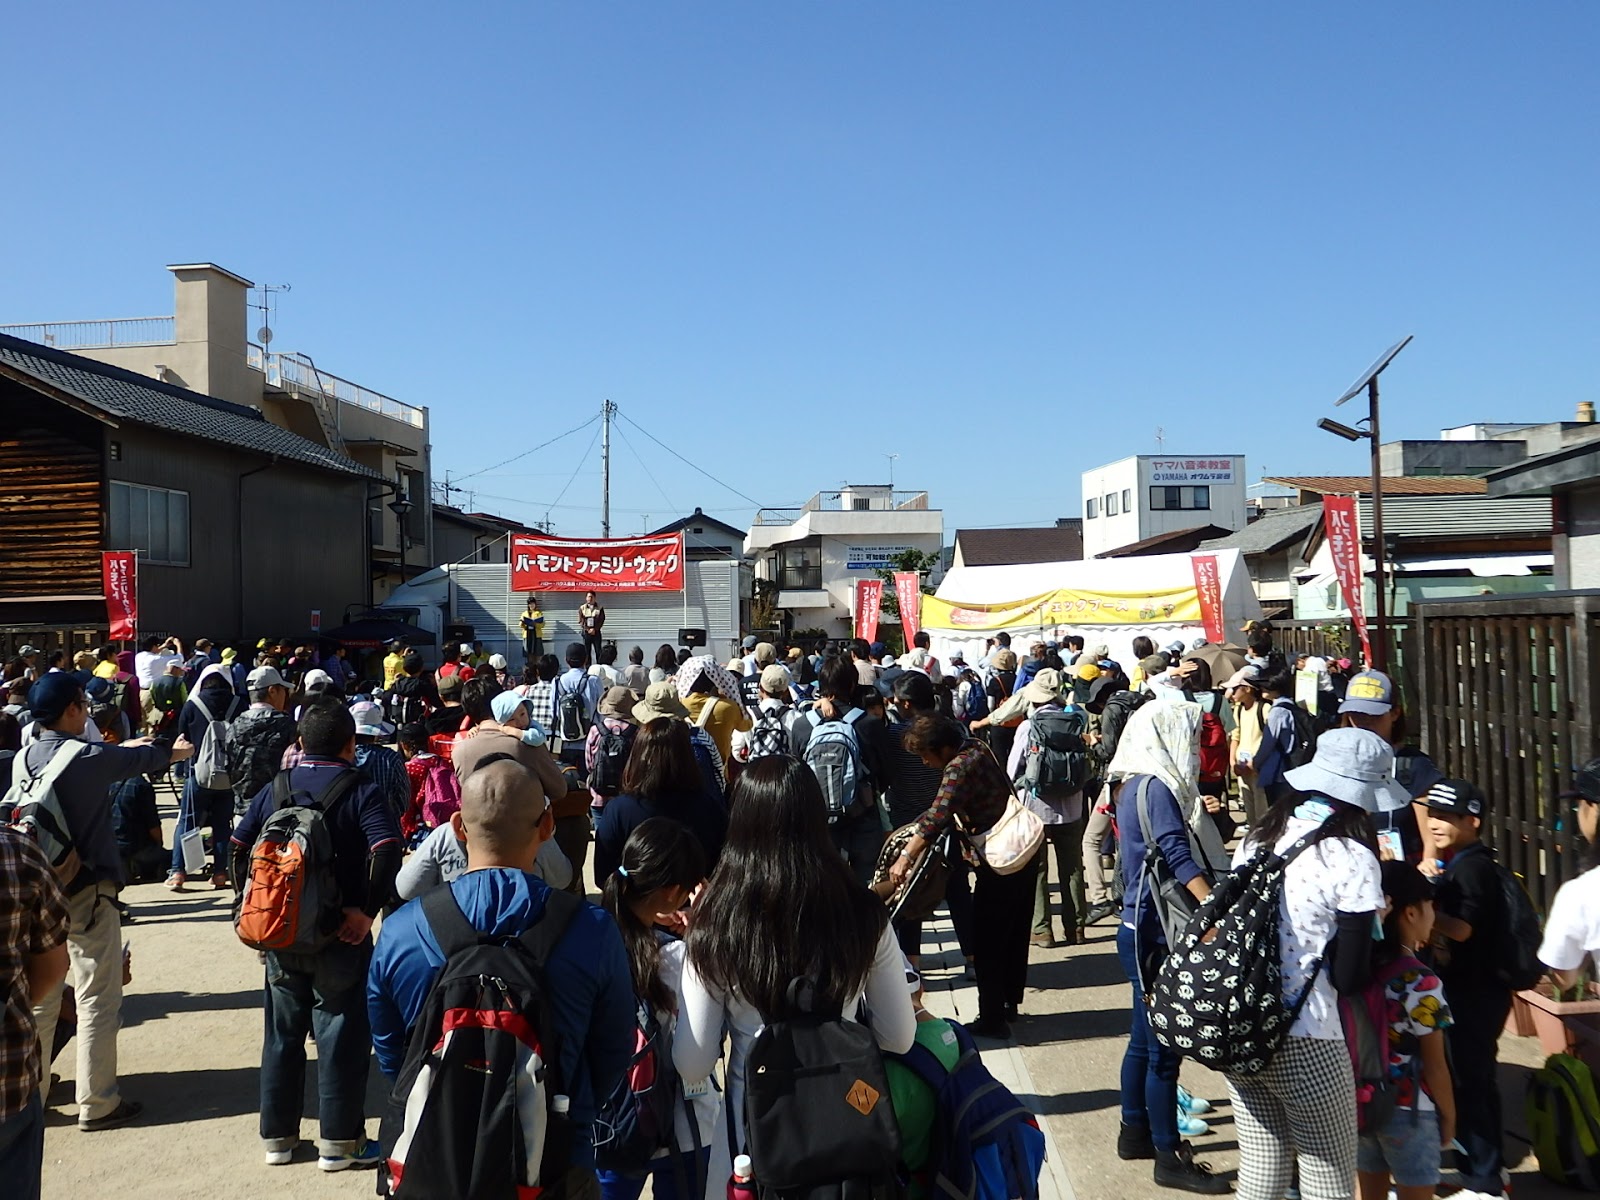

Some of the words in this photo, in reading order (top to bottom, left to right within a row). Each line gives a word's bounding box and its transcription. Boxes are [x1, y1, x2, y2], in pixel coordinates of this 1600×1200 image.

[1152, 460, 1231, 470] ヤマハ音楽教室
[869, 586, 878, 624] バーモント
